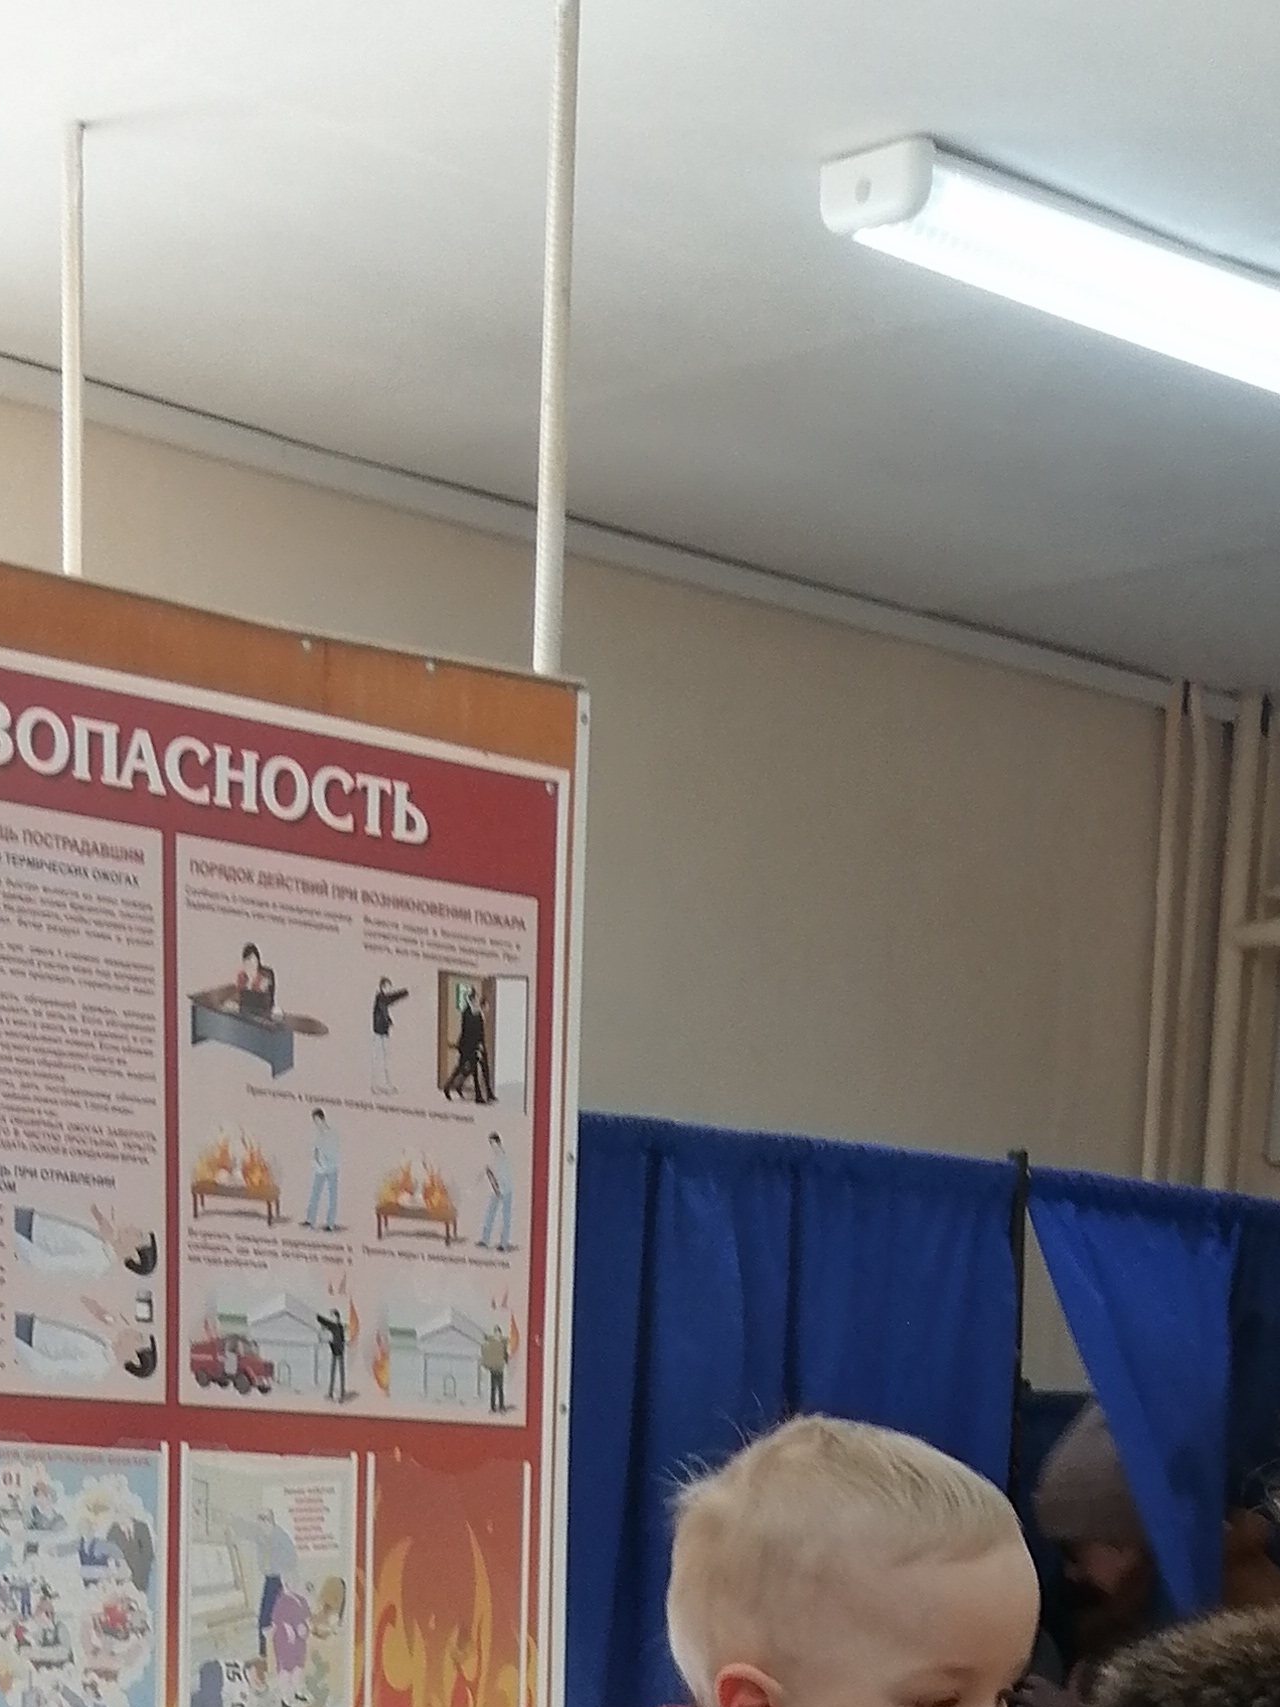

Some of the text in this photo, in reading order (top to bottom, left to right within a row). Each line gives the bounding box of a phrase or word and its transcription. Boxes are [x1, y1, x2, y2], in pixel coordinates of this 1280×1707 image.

[23, 830, 144, 865] ПОСТРАДАВШИМ
[92, 868, 140, 888] ОЖОГАХ
[189, 859, 254, 883] ПОРЯДОК
[257, 869, 328, 898] ДЕЙСТВИЙ
[332, 883, 358, 902] ПРИ
[474, 910, 526, 932] ПОЖАРА
[14, 1165, 37, 1179] ПРИ
